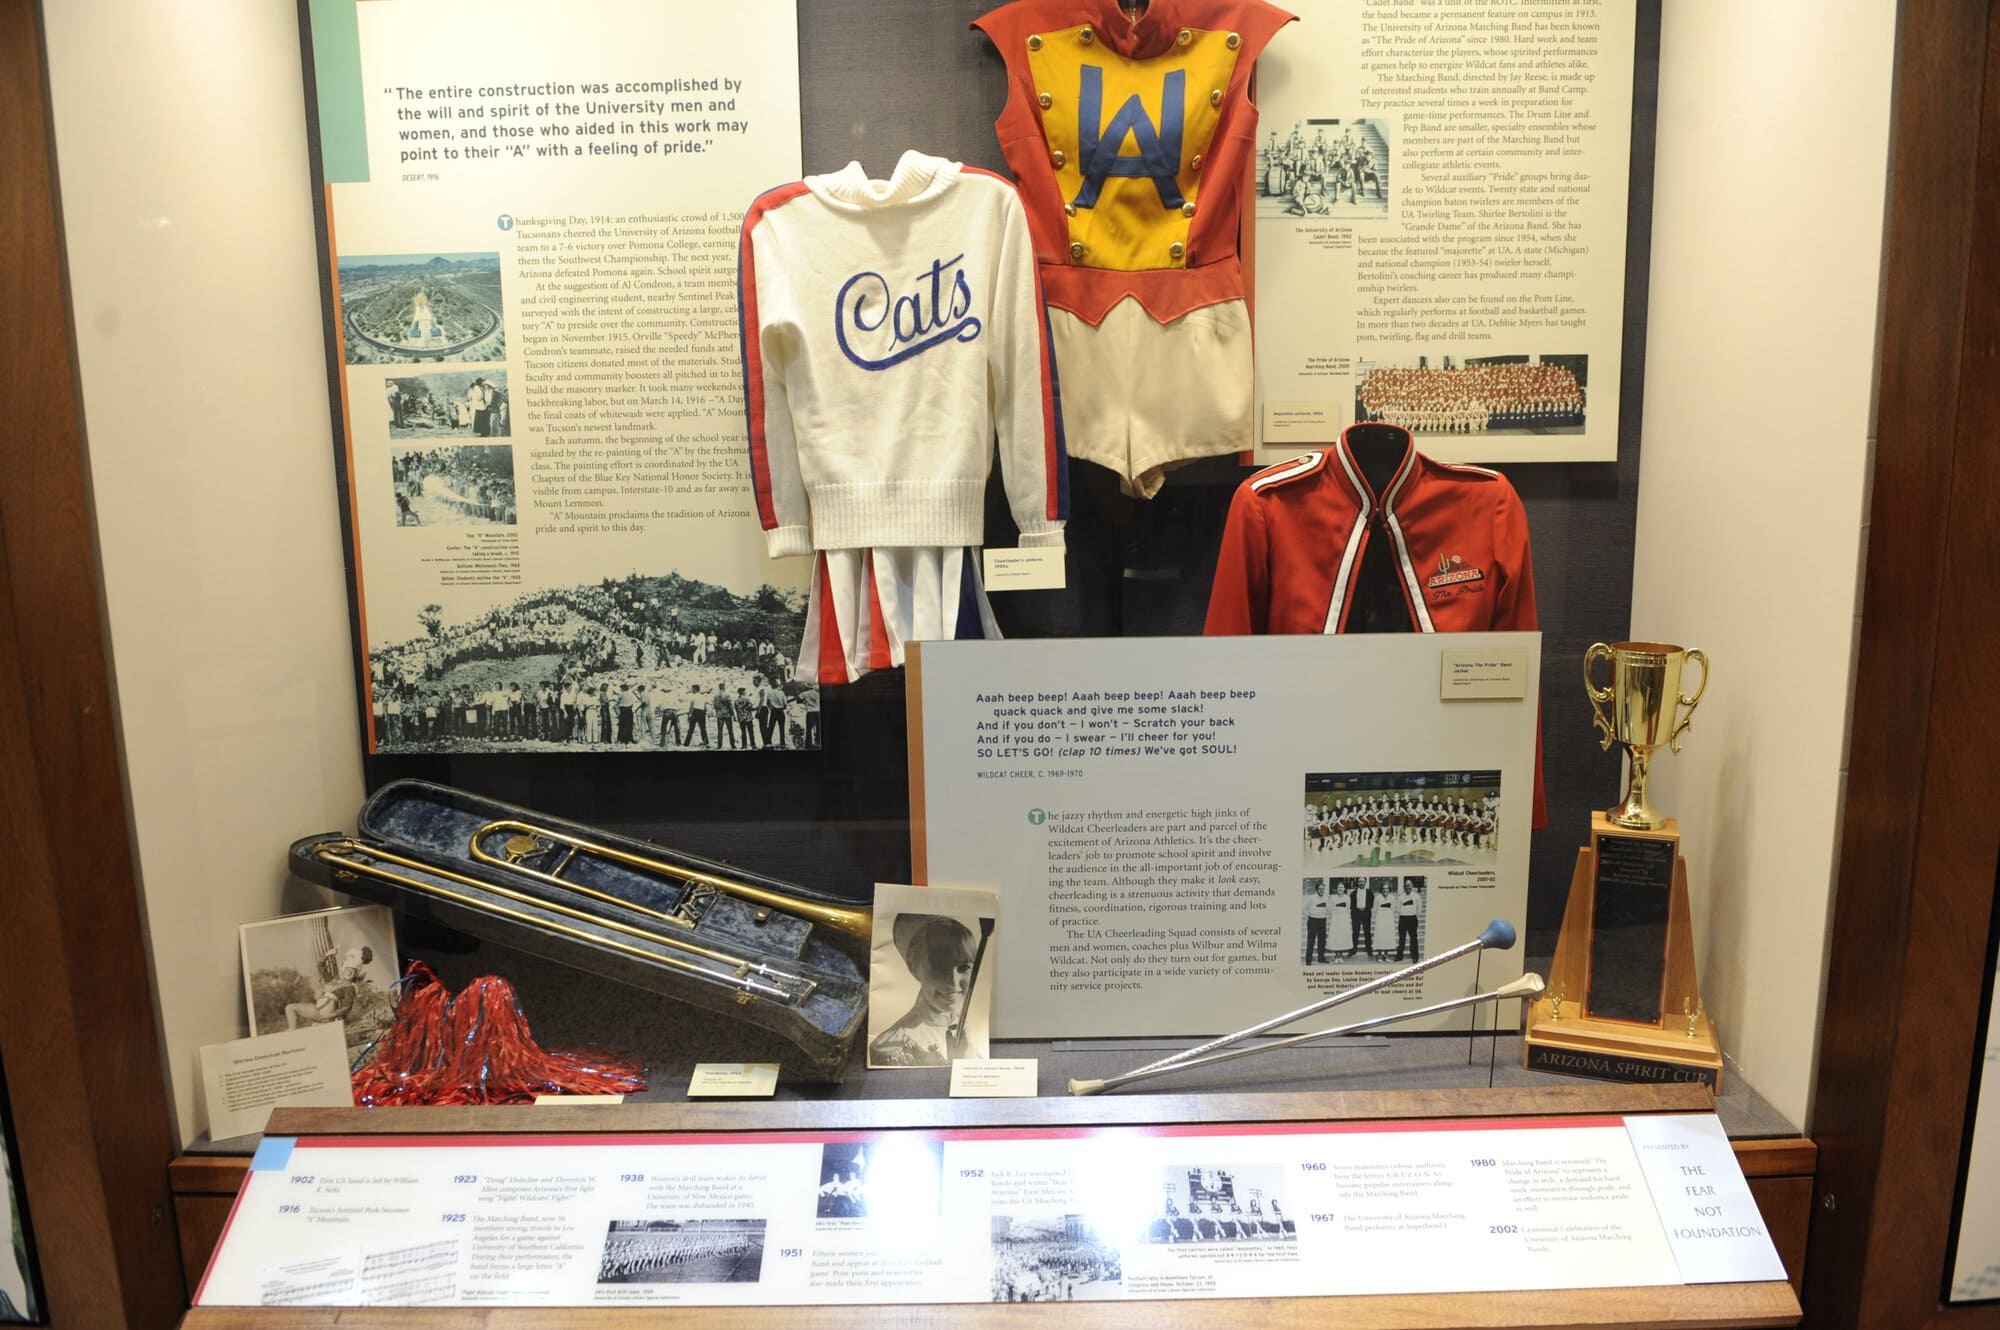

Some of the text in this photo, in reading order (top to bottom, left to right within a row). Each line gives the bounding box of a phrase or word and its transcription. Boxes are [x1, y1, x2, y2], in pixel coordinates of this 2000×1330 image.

[1361, 21, 1600, 34] The University of Arizona Marching Band has been known
[429, 85, 473, 99] entire
[478, 82, 575, 98] construction
[580, 83, 609, 94] was
[615, 78, 719, 95] accomplished
[724, 77, 742, 94] by
[397, 98, 736, 121] the will and spirit of the University men and
[399, 119, 748, 141] women, and those who aided in this work may
[400, 139, 713, 164] point to their "A" with a feeling of pride."
[1401, 210, 1415, 219] UA
[1416, 209, 1451, 221] Twirling
[1452, 210, 1477, 219] Team.
[1478, 209, 1507, 218] Shirlee
[1508, 208, 1544, 218] Bertolini
[1554, 208, 1568, 218] the
[518, 252, 732, 266] them the Southwest Championship. The next year,
[835, 253, 981, 371] Cats
[546, 423, 582, 433] Tucson's
[584, 424, 612, 432] newest
[614, 421, 657, 432] landmark.
[976, 689, 1256, 704] Aaah beep beep! Aaah beep beep! Aaah beep beep
[993, 704, 1204, 718] quack quack and give me some slack!
[976, 717, 1235, 732] And if you don't I won't Scratch your back
[976, 731, 1216, 746] And if you do I swear I'll cheer for you!
[977, 744, 1237, 758] SO LET'S GO! (clap 10 times) We've got SOUL!
[977, 770, 1007, 779] WILDCAT
[1009, 770, 1036, 779] CHEER,
[1048, 824, 1084, 834] Wildcat
[1086, 823, 1148, 833] Cheerleaders
[1166, 824, 1186, 834] part
[1189, 822, 1207, 832] and
[1209, 821, 1238, 834] parcel
[1240, 821, 1251, 831] of
[1253, 820, 1268, 831] the
[1537, 1052, 1707, 1083] ARIZONA SPIRIT CUP
[1471, 1159, 1496, 1167] 1980
[960, 1169, 984, 1178] 1952
[1680, 1165, 1705, 1176] THE
[291, 1176, 314, 1184] 1902
[454, 1175, 478, 1184] 1923
[620, 1174, 644, 1182] 1938
[1686, 1185, 1716, 1196] FEAR
[279, 1204, 300, 1213] 1916
[1694, 1206, 1722, 1216] NOT
[442, 1214, 465, 1222] 1925
[1310, 1214, 1334, 1222] 1967
[1490, 1225, 1518, 1234] 2002
[1674, 1226, 1761, 1239] FOUNDATION
[781, 1248, 803, 1257] 1951
